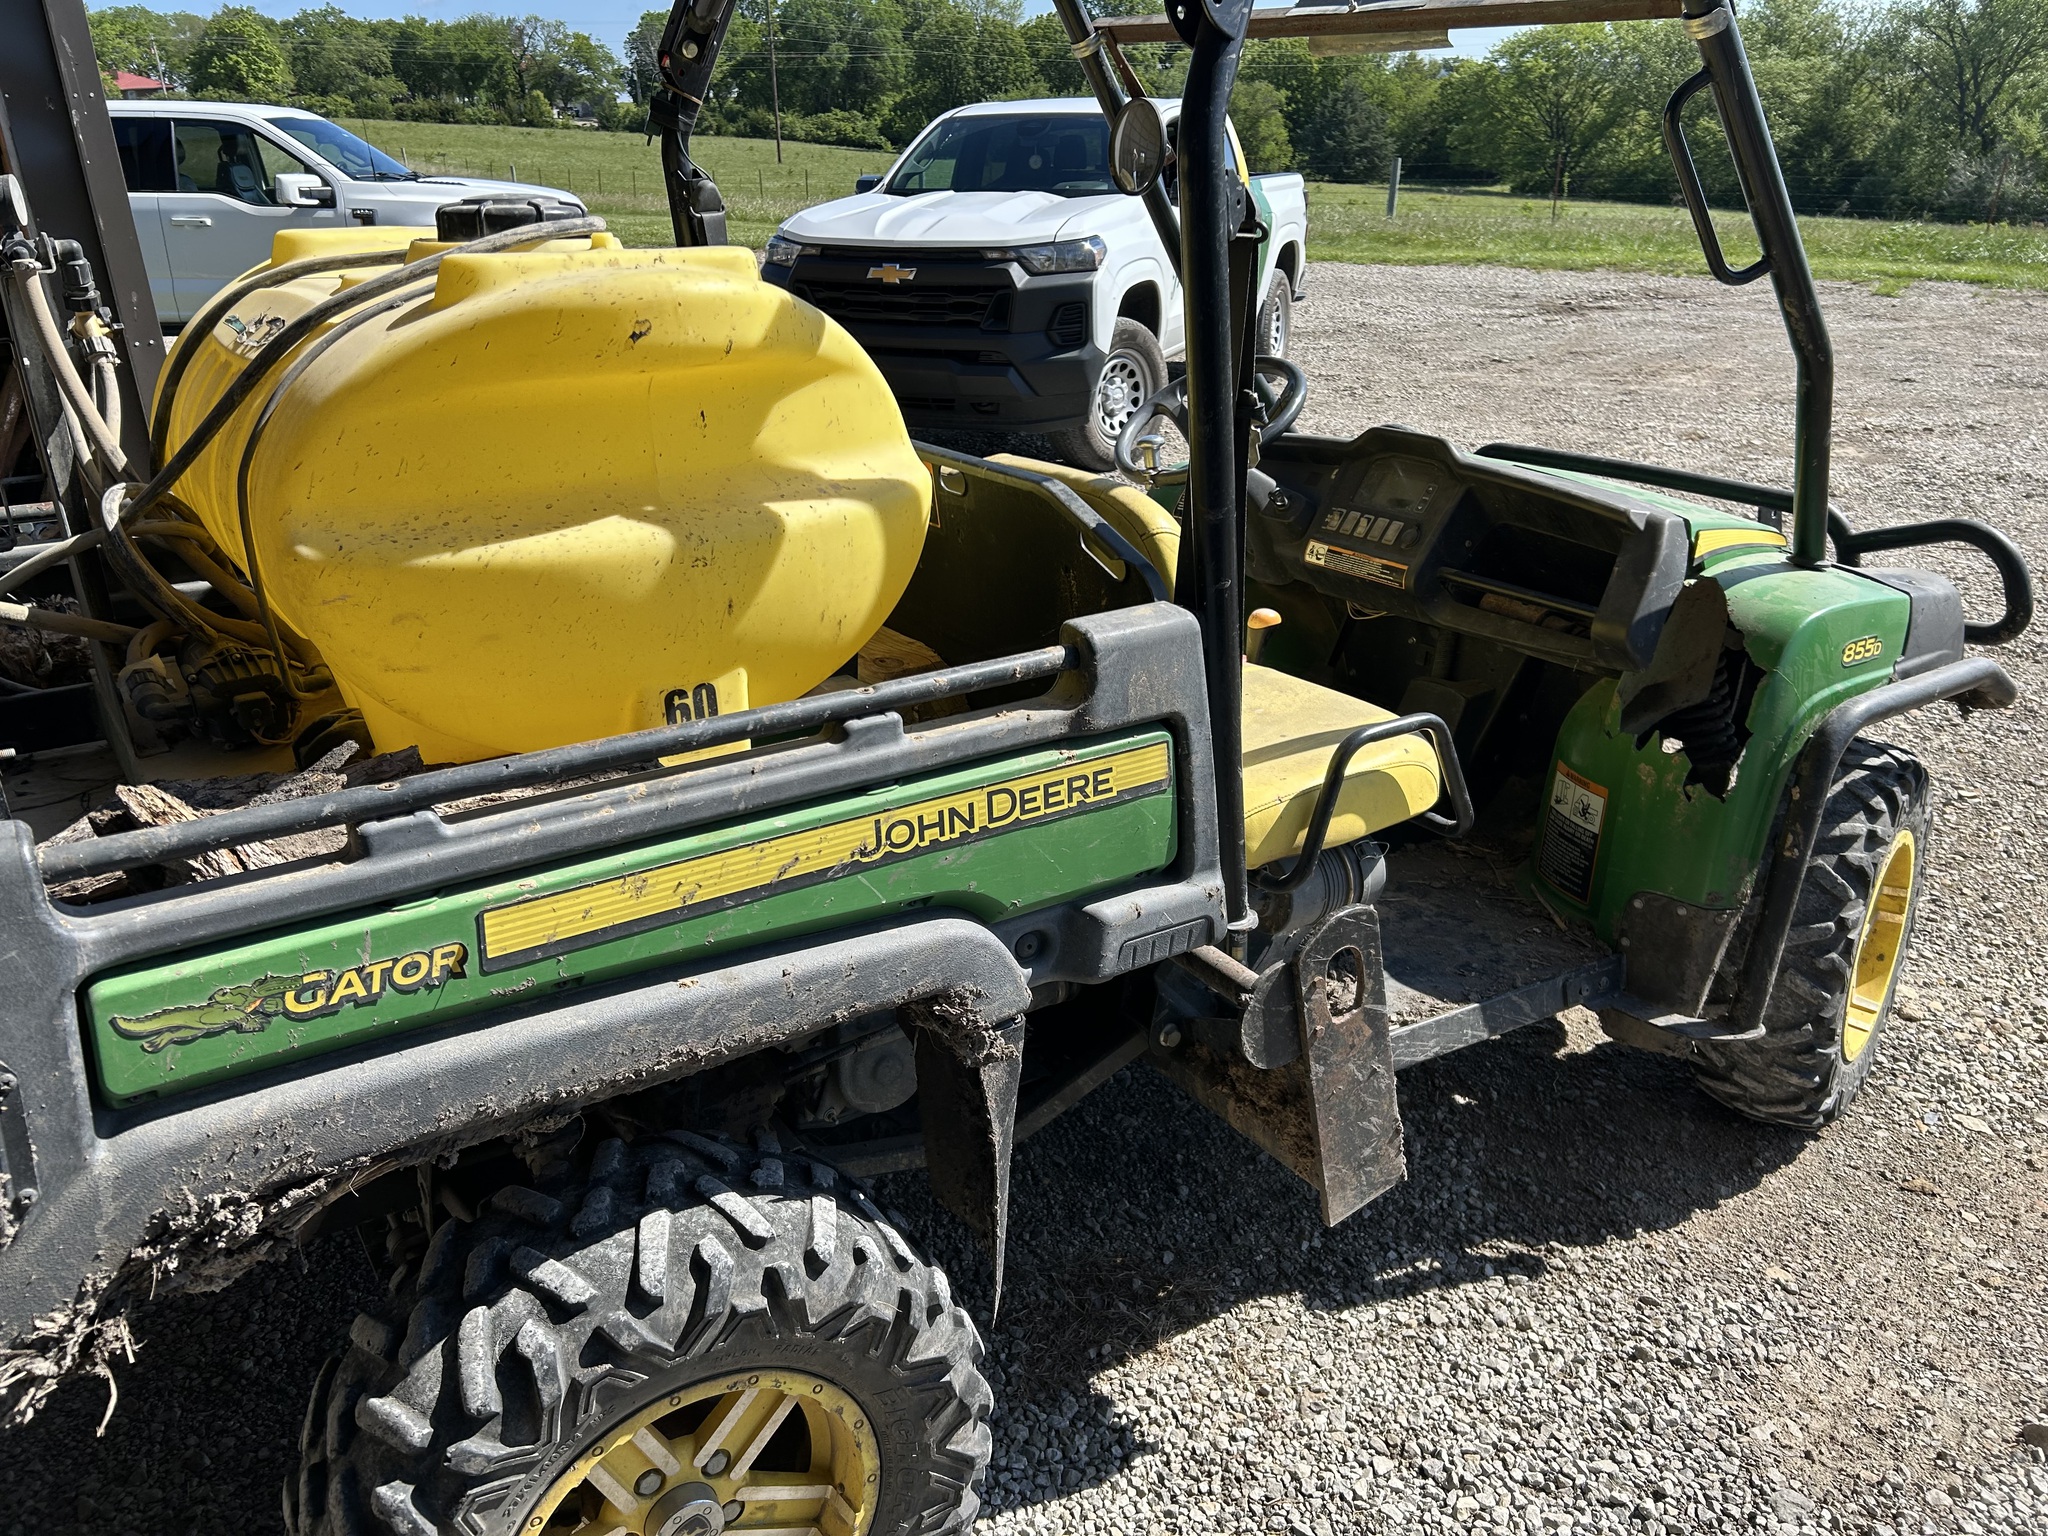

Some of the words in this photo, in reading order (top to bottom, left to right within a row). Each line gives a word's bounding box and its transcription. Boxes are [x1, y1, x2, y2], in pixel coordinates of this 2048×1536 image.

[1842, 637, 1882, 663] 855D
[664, 682, 719, 725] 60
[859, 802, 976, 859] JOHN
[986, 767, 1114, 824] DEERE
[284, 942, 465, 1014] GATOR
